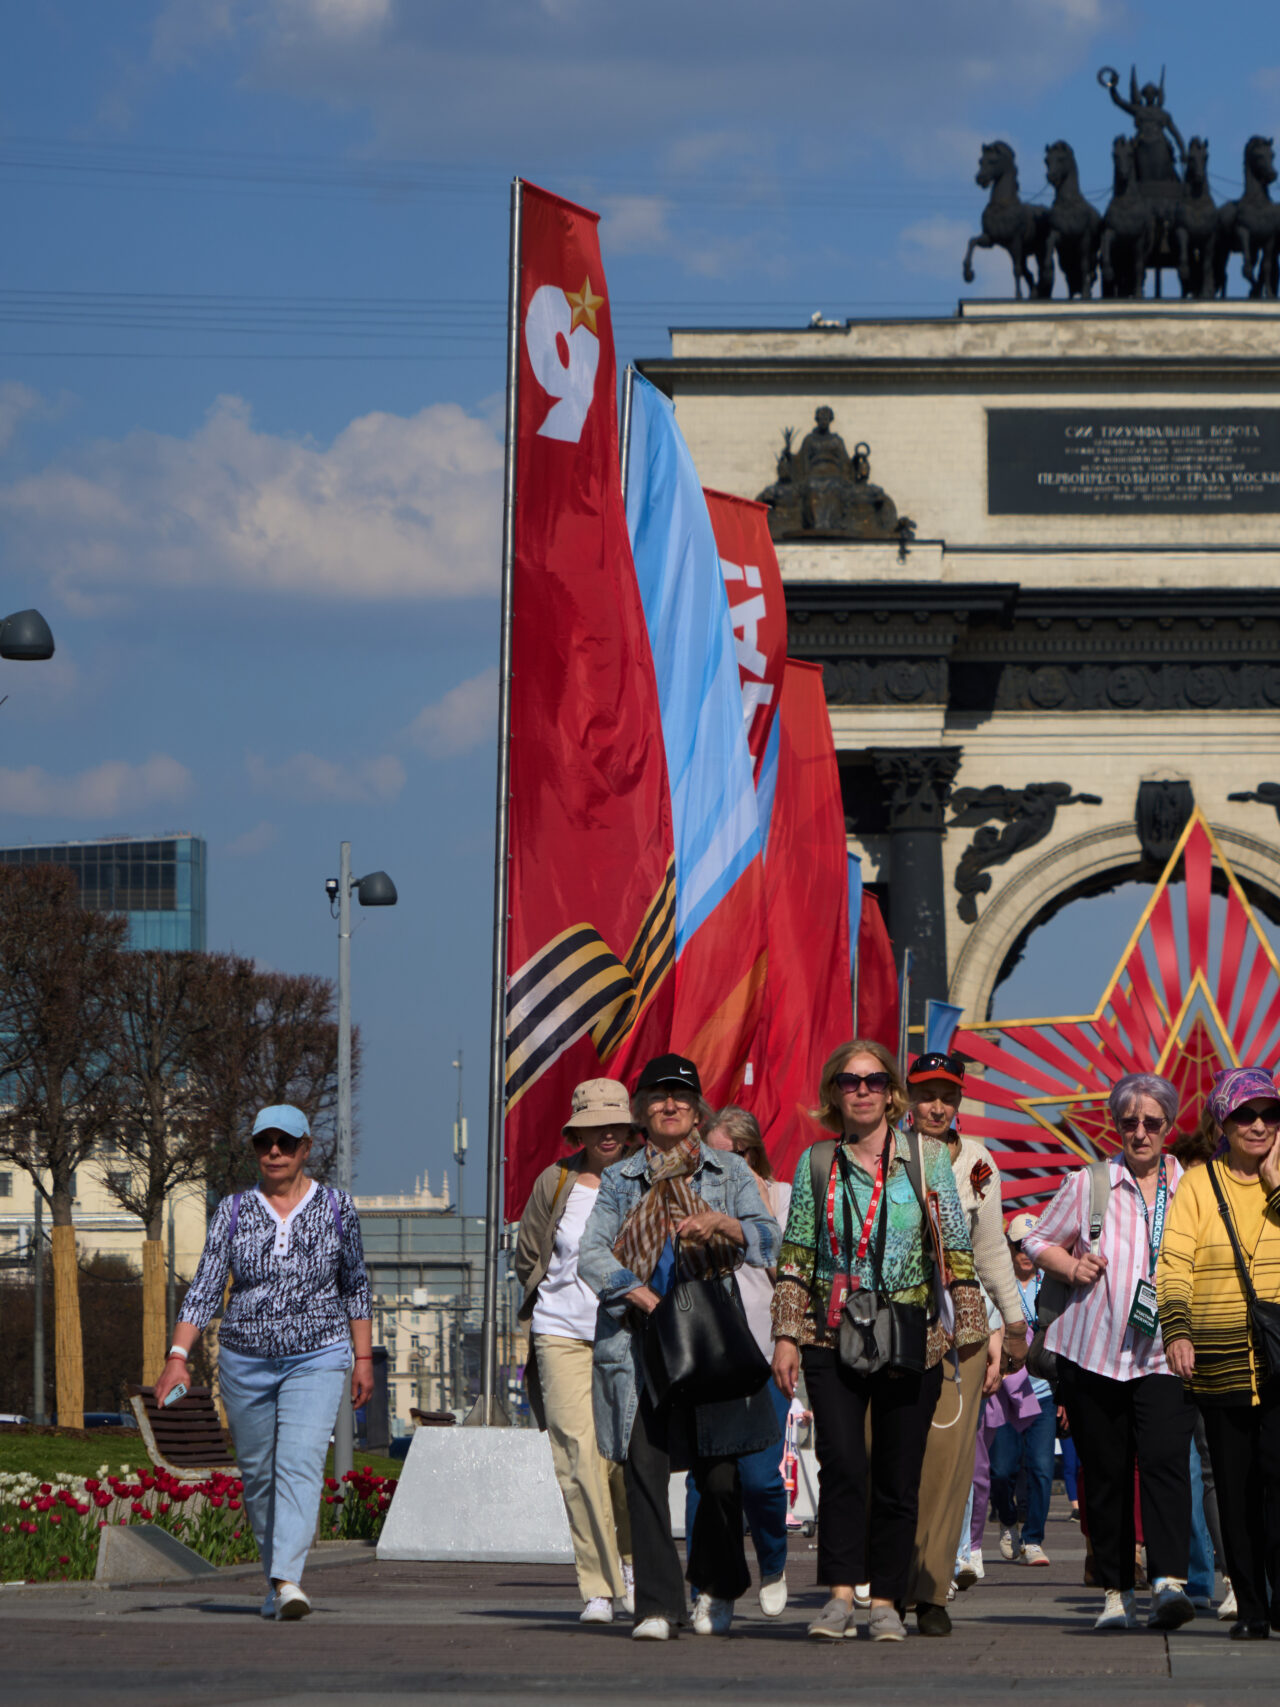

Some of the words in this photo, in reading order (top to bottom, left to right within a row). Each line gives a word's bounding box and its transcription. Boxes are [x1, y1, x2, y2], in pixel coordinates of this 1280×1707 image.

[526, 284, 600, 443] 9
[1101, 425, 1202, 438] ТРИУМФАЛЬНЫЕ
[1210, 425, 1260, 438] ВОРОТА
[1037, 472, 1181, 485] ПЕРВОПРЕСТОЛЬНОГО
[1152, 1189, 1165, 1248] МОСКОВСКОЕ
